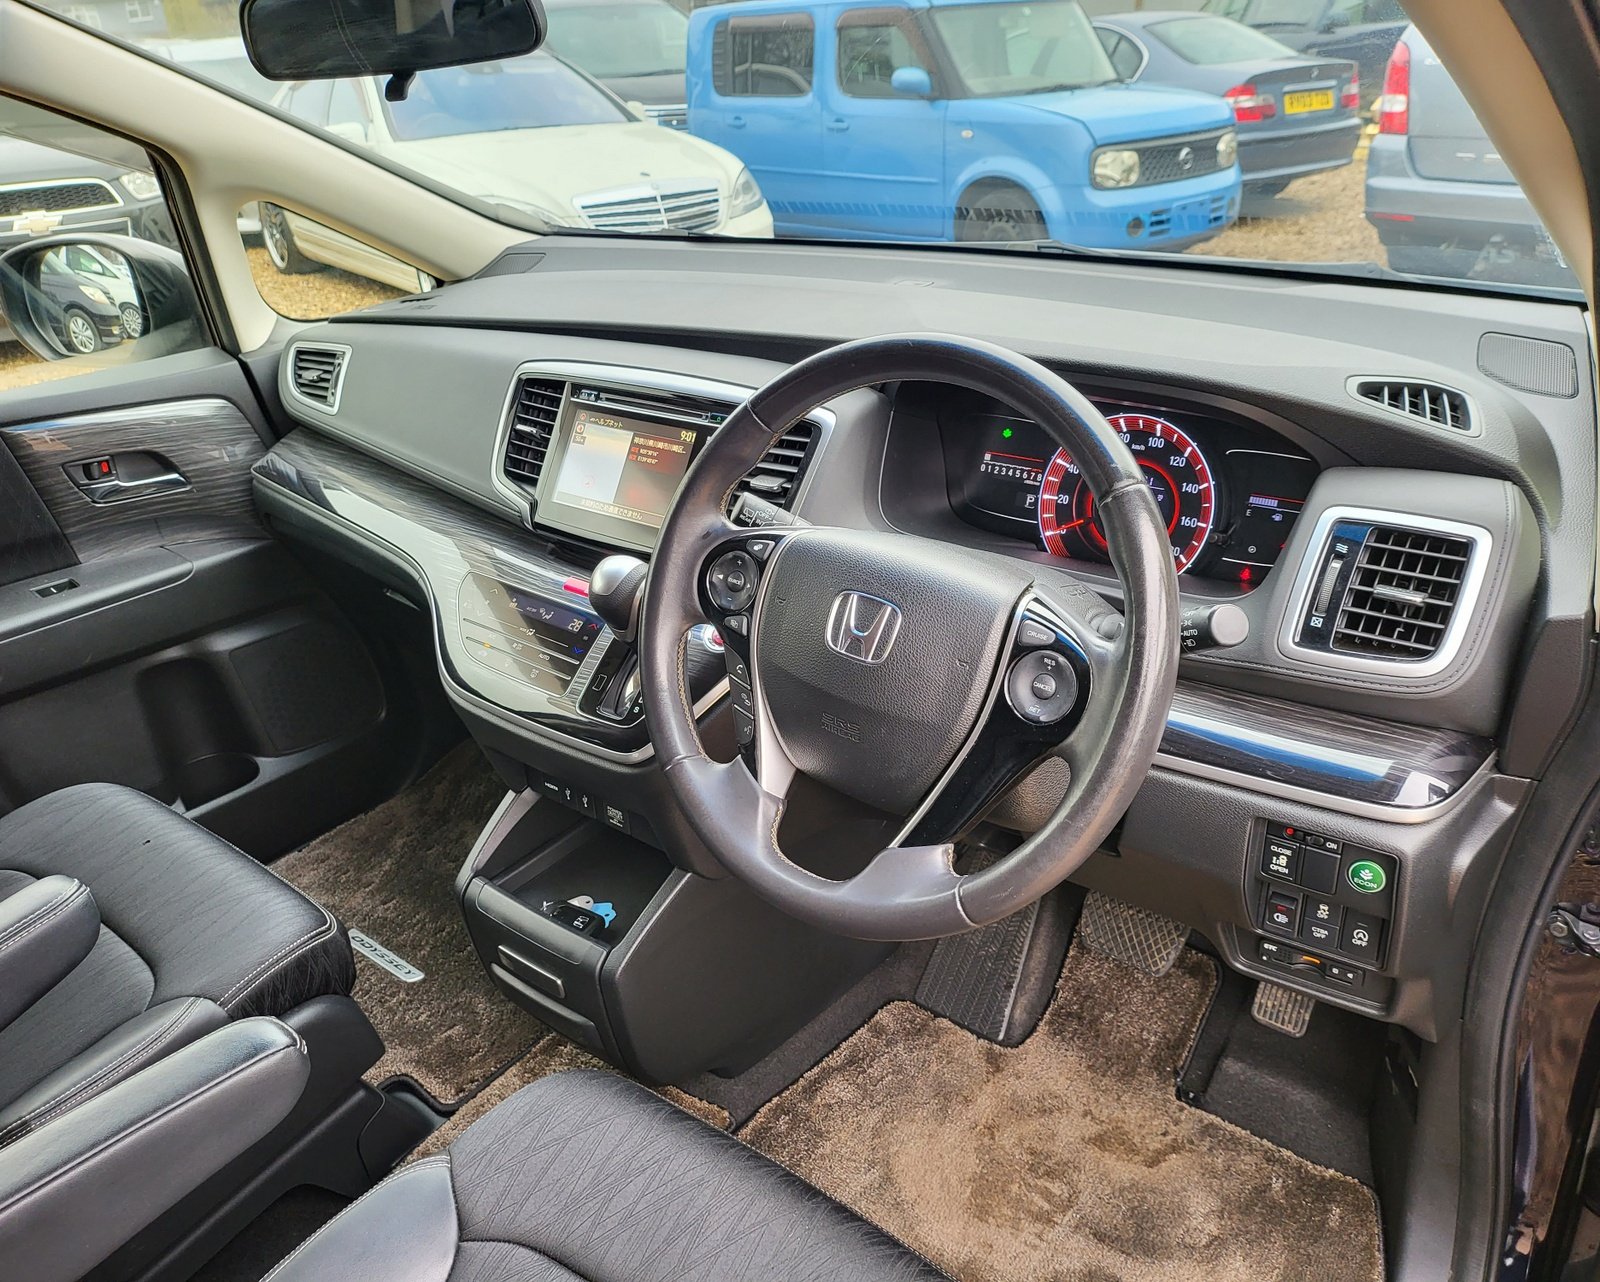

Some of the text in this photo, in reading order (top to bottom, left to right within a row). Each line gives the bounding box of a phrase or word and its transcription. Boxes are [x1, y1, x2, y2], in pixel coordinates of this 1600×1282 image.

[680, 430, 697, 443] 9:01
[1131, 443, 1146, 451] km/h
[1148, 437, 1165, 448] 100
[1169, 456, 1186, 467] 120
[1067, 464, 1079, 474] 40
[1182, 482, 1199, 494] 140
[1025, 494, 1035, 507] P
[1057, 494, 1069, 505] 20
[758, 511, 770, 520] OFF
[1245, 509, 1252, 517] E
[1180, 516, 1198, 528] 160
[568, 619, 584, 632] 28
[1027, 630, 1048, 640] CRUISE
[1183, 629, 1198, 637] AUTO
[538, 653, 551, 661] AUTO
[1043, 657, 1056, 666] RES
[1033, 681, 1052, 691] CANCEL
[821, 712, 860, 733] SRS
[1271, 845, 1292, 856] CLOSE
[1326, 841, 1337, 850] ON
[1269, 863, 1289, 874] OPEN
[1353, 877, 1378, 889] ECON
[1316, 911, 1329, 920] OFF
[1312, 931, 1327, 940] OFF
[1263, 942, 1278, 952] ETC
[1351, 938, 1369, 947] OFF
[351, 935, 416, 975] ODYSSEY
